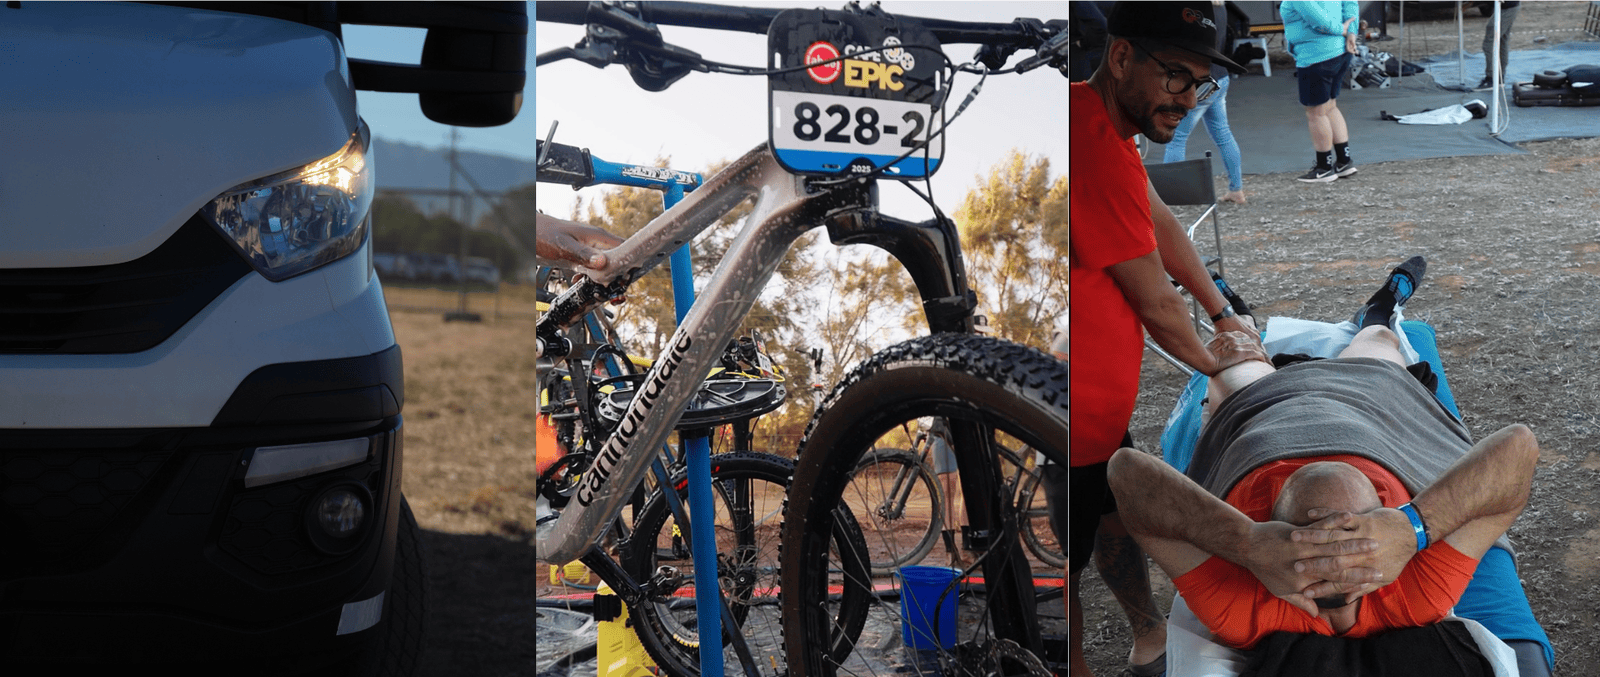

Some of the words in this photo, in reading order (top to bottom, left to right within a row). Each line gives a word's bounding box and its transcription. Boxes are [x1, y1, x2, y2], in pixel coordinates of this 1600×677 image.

[844, 59, 905, 91] EPIC
[793, 101, 926, 149] 828-2
[851, 164, 872, 173] 2025
[577, 328, 692, 507] cannondale
